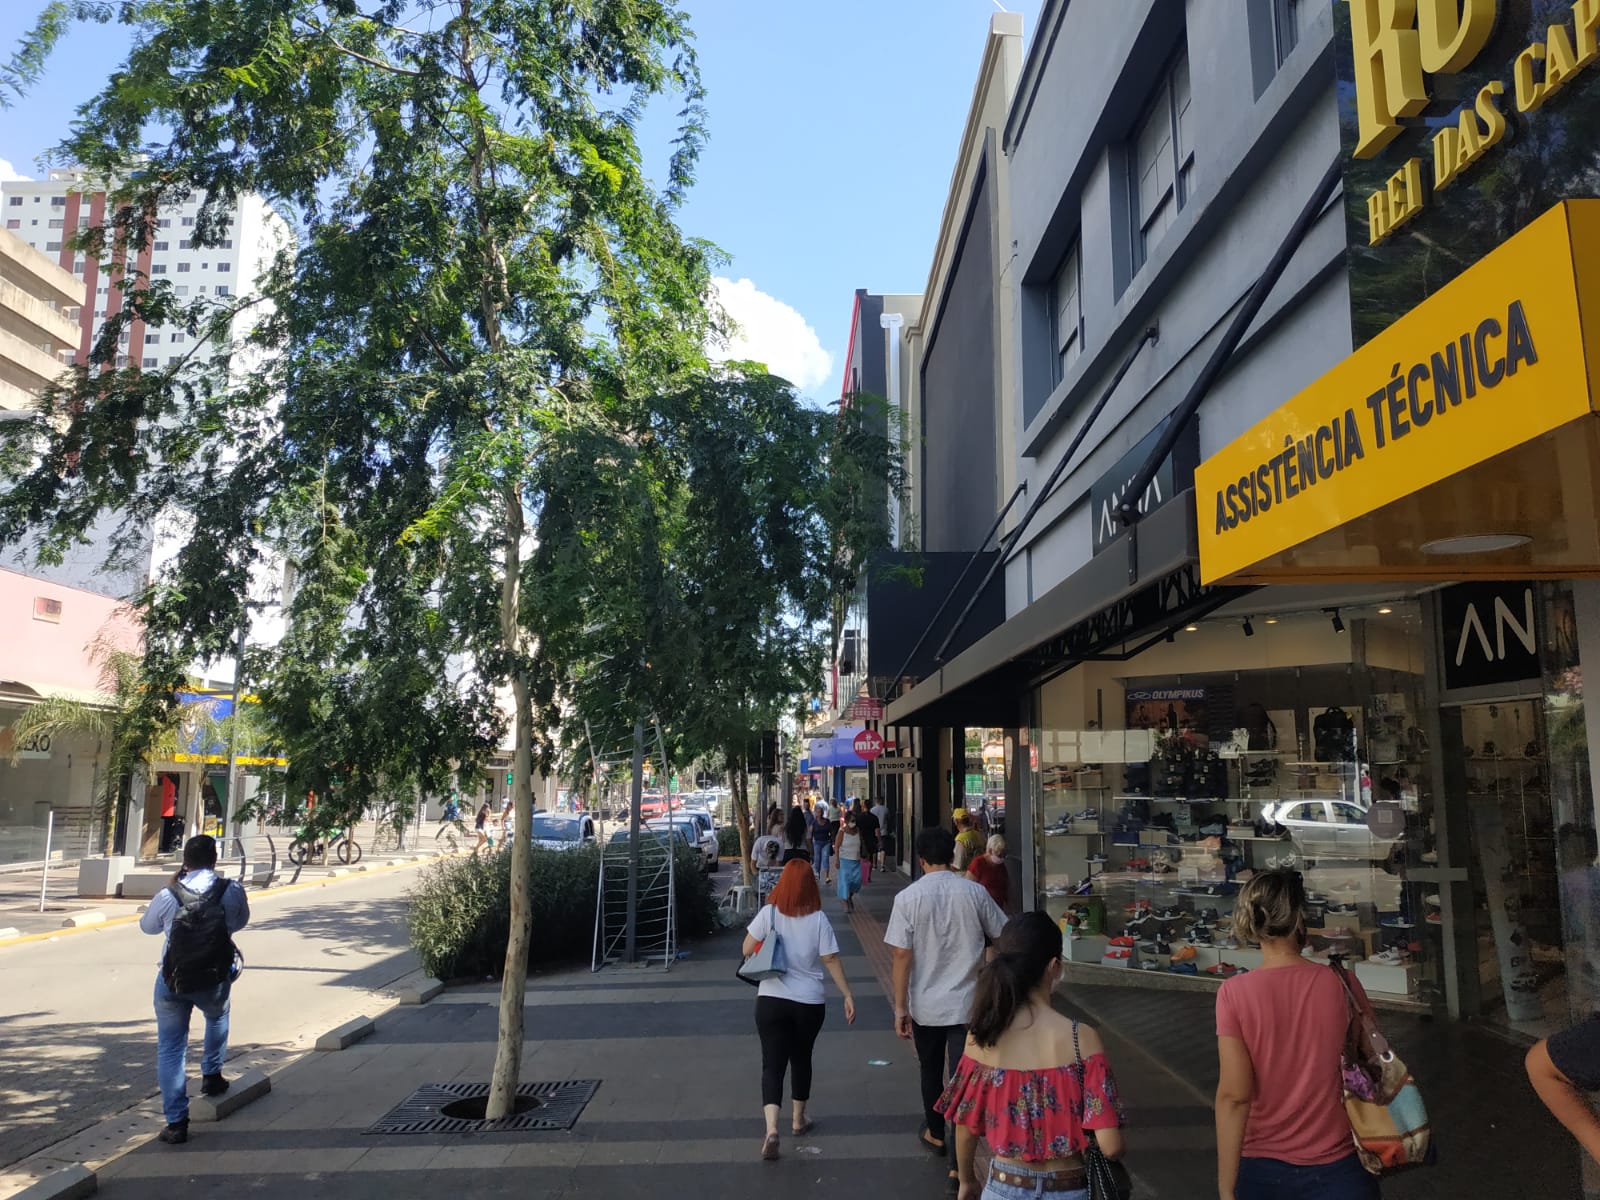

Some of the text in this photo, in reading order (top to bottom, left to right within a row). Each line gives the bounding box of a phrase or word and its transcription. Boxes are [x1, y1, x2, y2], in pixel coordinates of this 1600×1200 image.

[1367, 157, 1424, 247] REI
[1432, 80, 1506, 191] DAS
[1215, 300, 1538, 535] ASSISTÊNCIA TÉCNICA
[1152, 689, 1205, 700] OLYMPIKUS
[854, 733, 881, 751] mix
[878, 762, 905, 770] STUDIO
